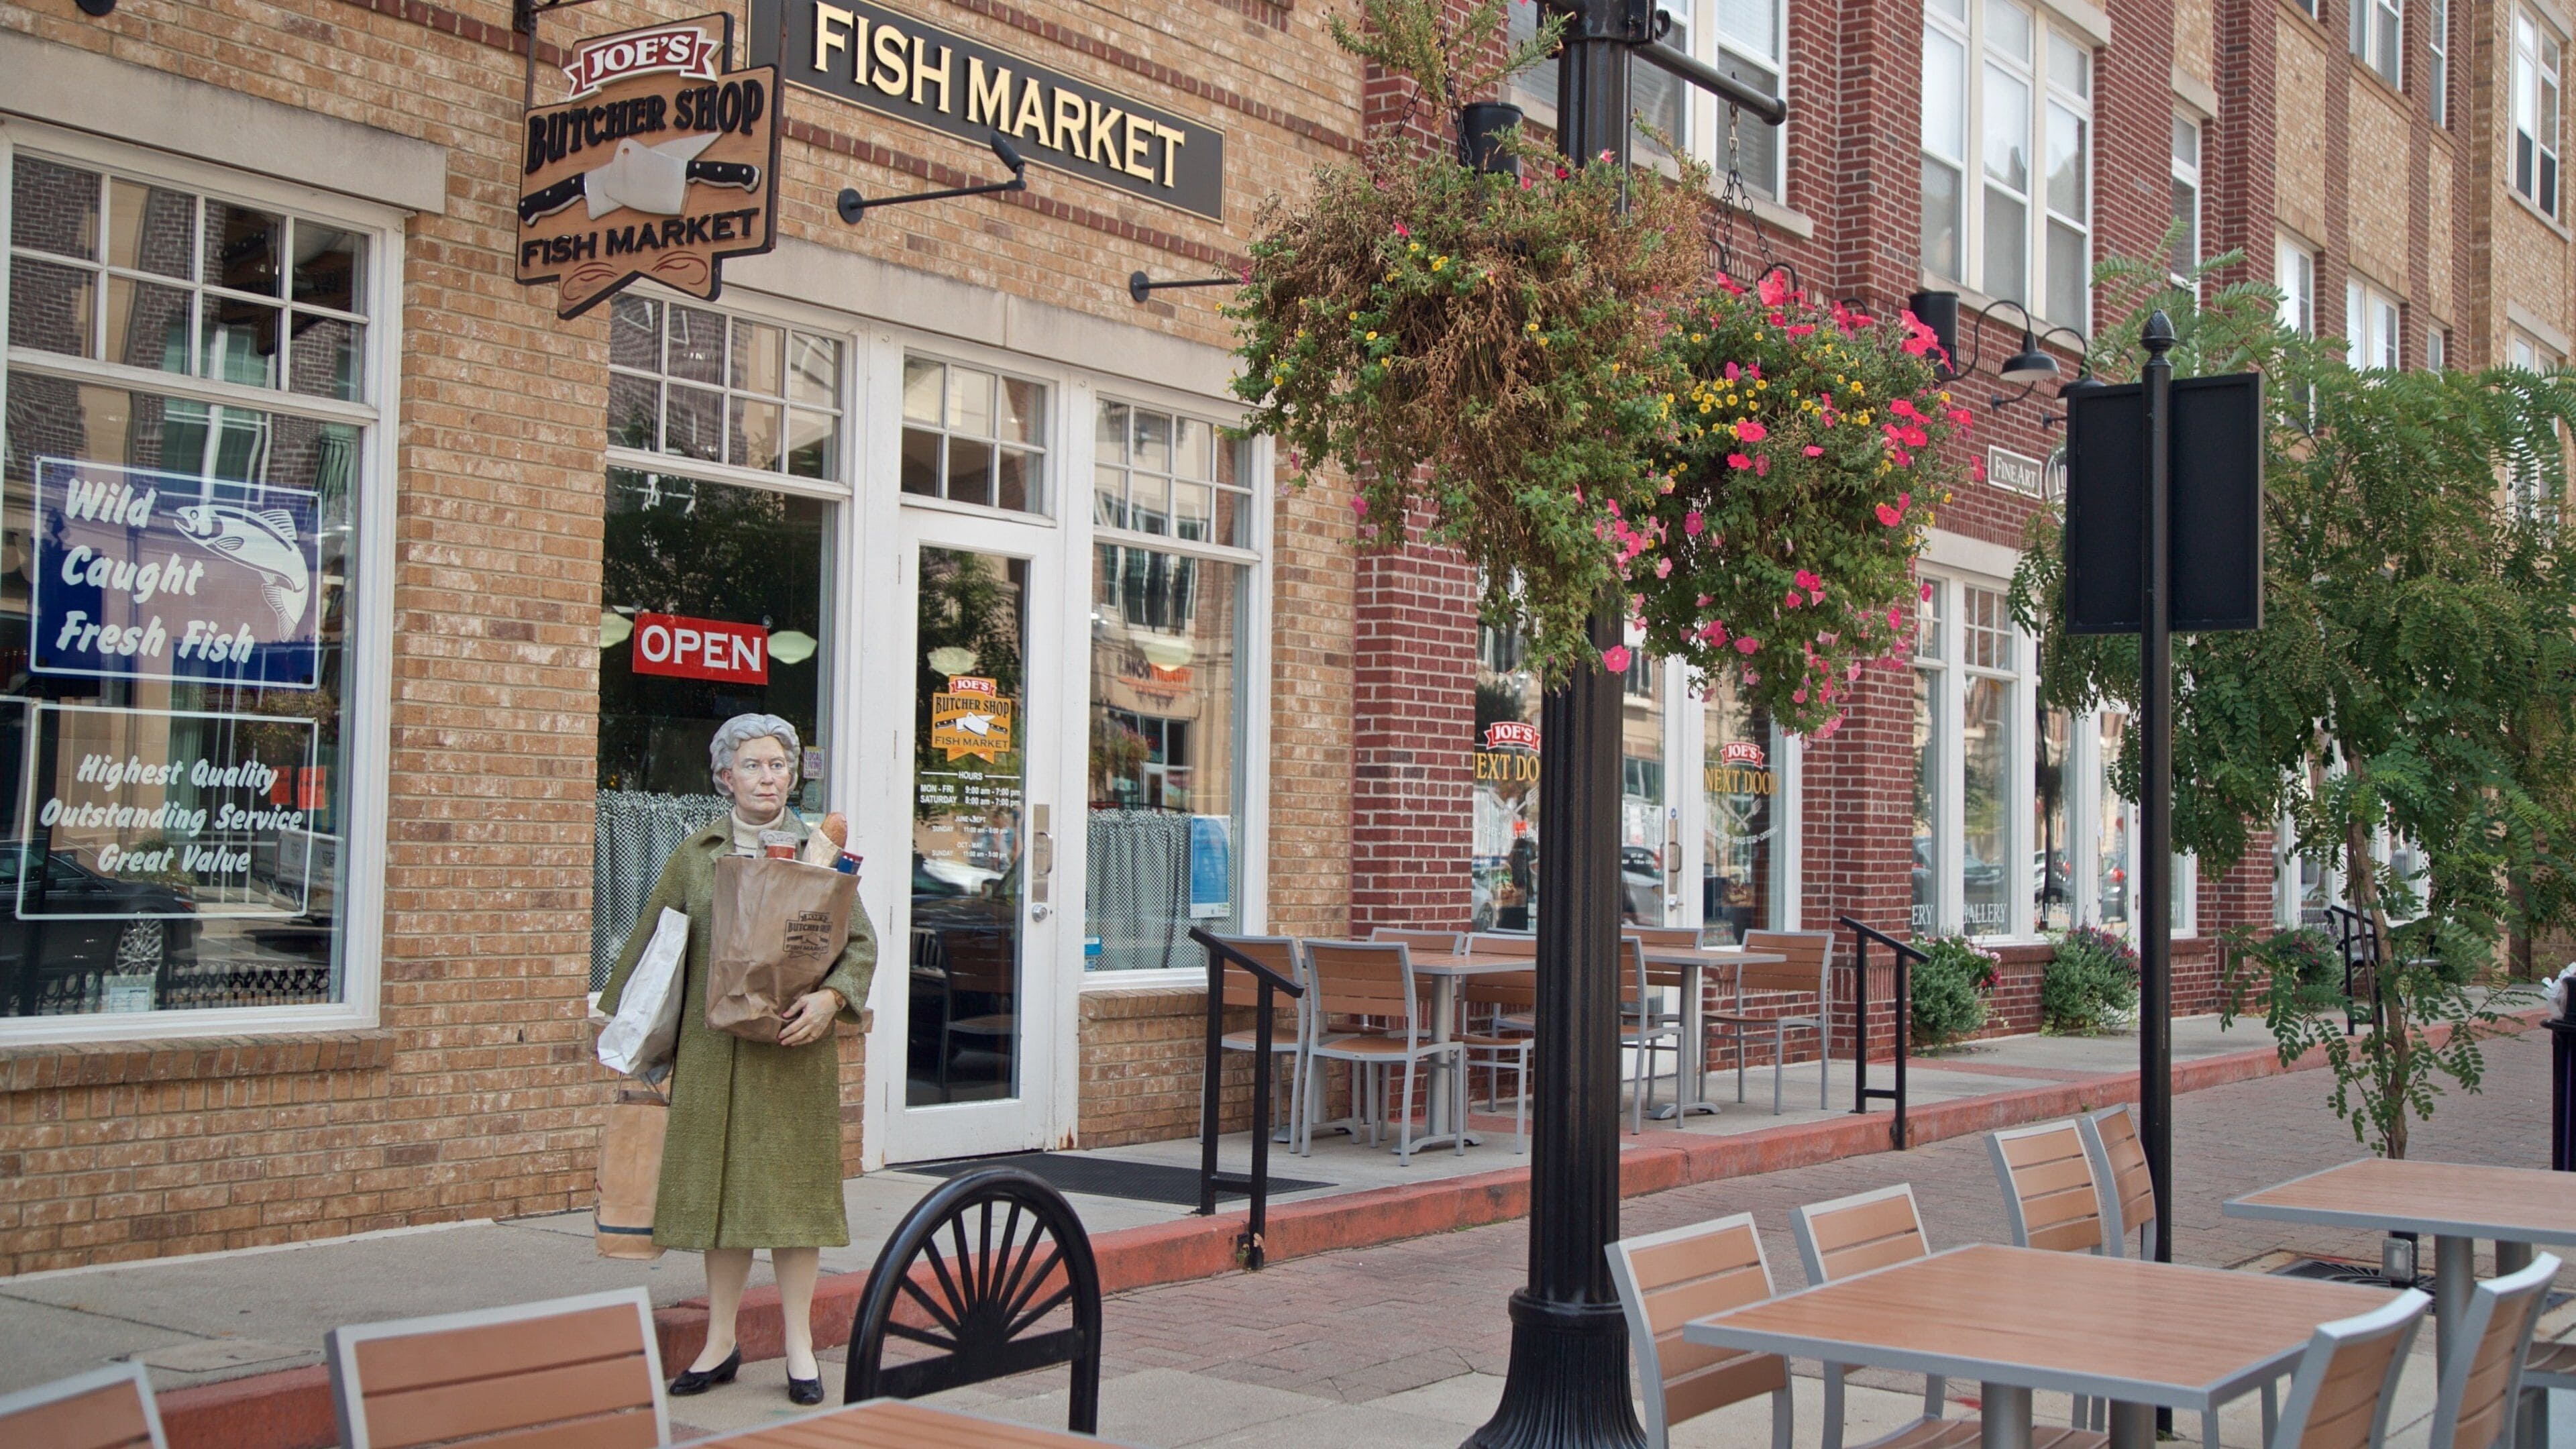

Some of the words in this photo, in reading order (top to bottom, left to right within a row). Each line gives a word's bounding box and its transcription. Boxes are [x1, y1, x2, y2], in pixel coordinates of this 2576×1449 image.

[590, 35, 692, 78] JOE'S
[814, 2, 952, 113] FISH
[967, 56, 1185, 188] MARKET
[525, 95, 667, 175] BUTCHER
[674, 79, 765, 135] SHOP
[521, 231, 598, 267] FISH
[606, 207, 759, 256] MARKET
[1995, 455, 2017, 483] FINE
[2017, 464, 2037, 488] ART
[66, 478, 157, 528] Wild
[60, 545, 204, 603] Caught
[56, 610, 167, 657] Fresh
[177, 621, 255, 663] Fish
[641, 625, 761, 672] OPEN
[957, 680, 989, 690] JOE'S
[936, 697, 981, 714] BUTCHER
[983, 700, 1009, 718] SHOP
[935, 736, 960, 745] FISH
[963, 739, 1008, 749] MARKET
[1495, 724, 1533, 741] JOE'S
[1473, 752, 1511, 781] EXT
[1515, 755, 1540, 782] DO
[1727, 744, 1758, 759] JOE'S
[76, 753, 182, 792] Highest
[191, 759, 278, 796] Quality
[958, 771, 983, 781] HOURS
[1704, 768, 1740, 792] NEXT
[1744, 771, 1780, 795] DOOR
[920, 784, 937, 792] MON
[942, 785, 954, 793] FRI
[965, 786, 979, 795] 9:00
[995, 788, 1009, 796] 7:00
[1010, 789, 1020, 797] pm
[920, 795, 957, 804] SATURDAY
[1010, 799, 1020, 807] pm
[39, 798, 207, 837] Outstanding
[214, 804, 304, 832] Service
[97, 843, 174, 873] Great
[182, 844, 252, 873] Value
